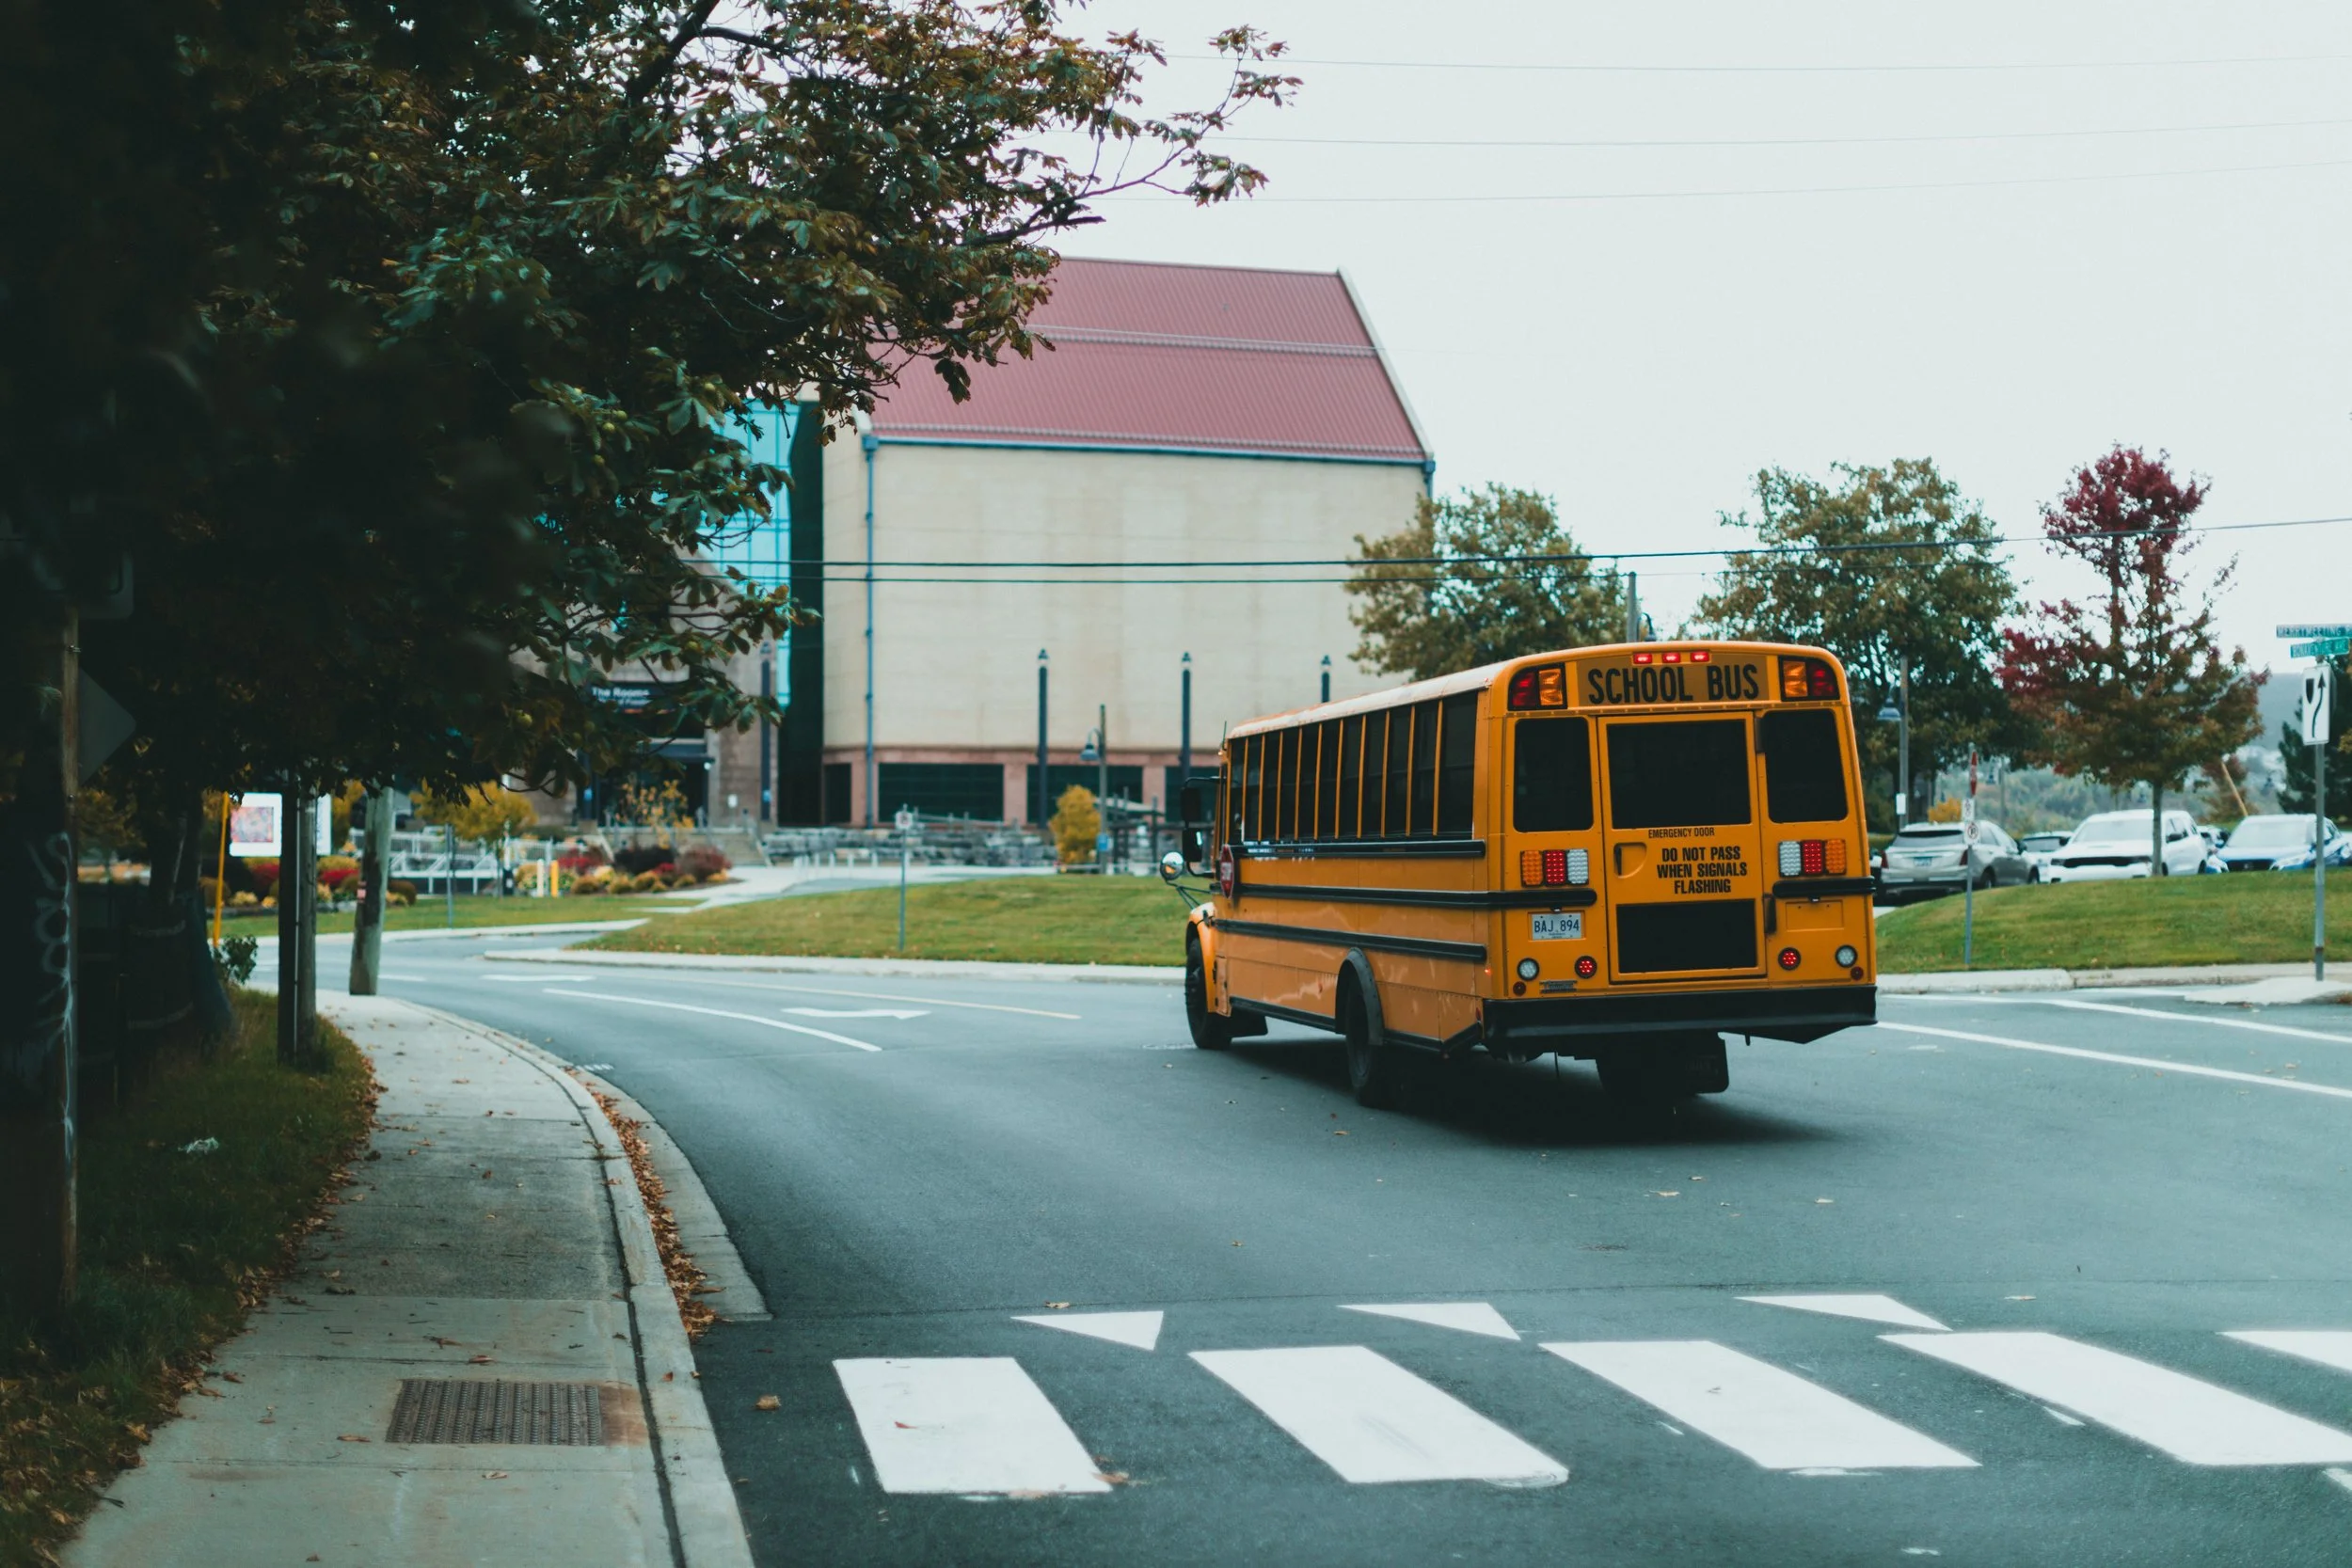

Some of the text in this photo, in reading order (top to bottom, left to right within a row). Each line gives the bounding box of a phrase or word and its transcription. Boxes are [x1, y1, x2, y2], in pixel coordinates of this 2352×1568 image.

[1587, 664, 1759, 705] SCHOOL BUS
[1648, 827, 1715, 839] EMERGENCY DOOR
[1661, 846, 1740, 863] DO NOT PASS
[1657, 862, 1747, 879] WHEN SIGNALS
[1674, 879, 1731, 895] FLASHING
[1534, 919, 1580, 933] BAJ 894
